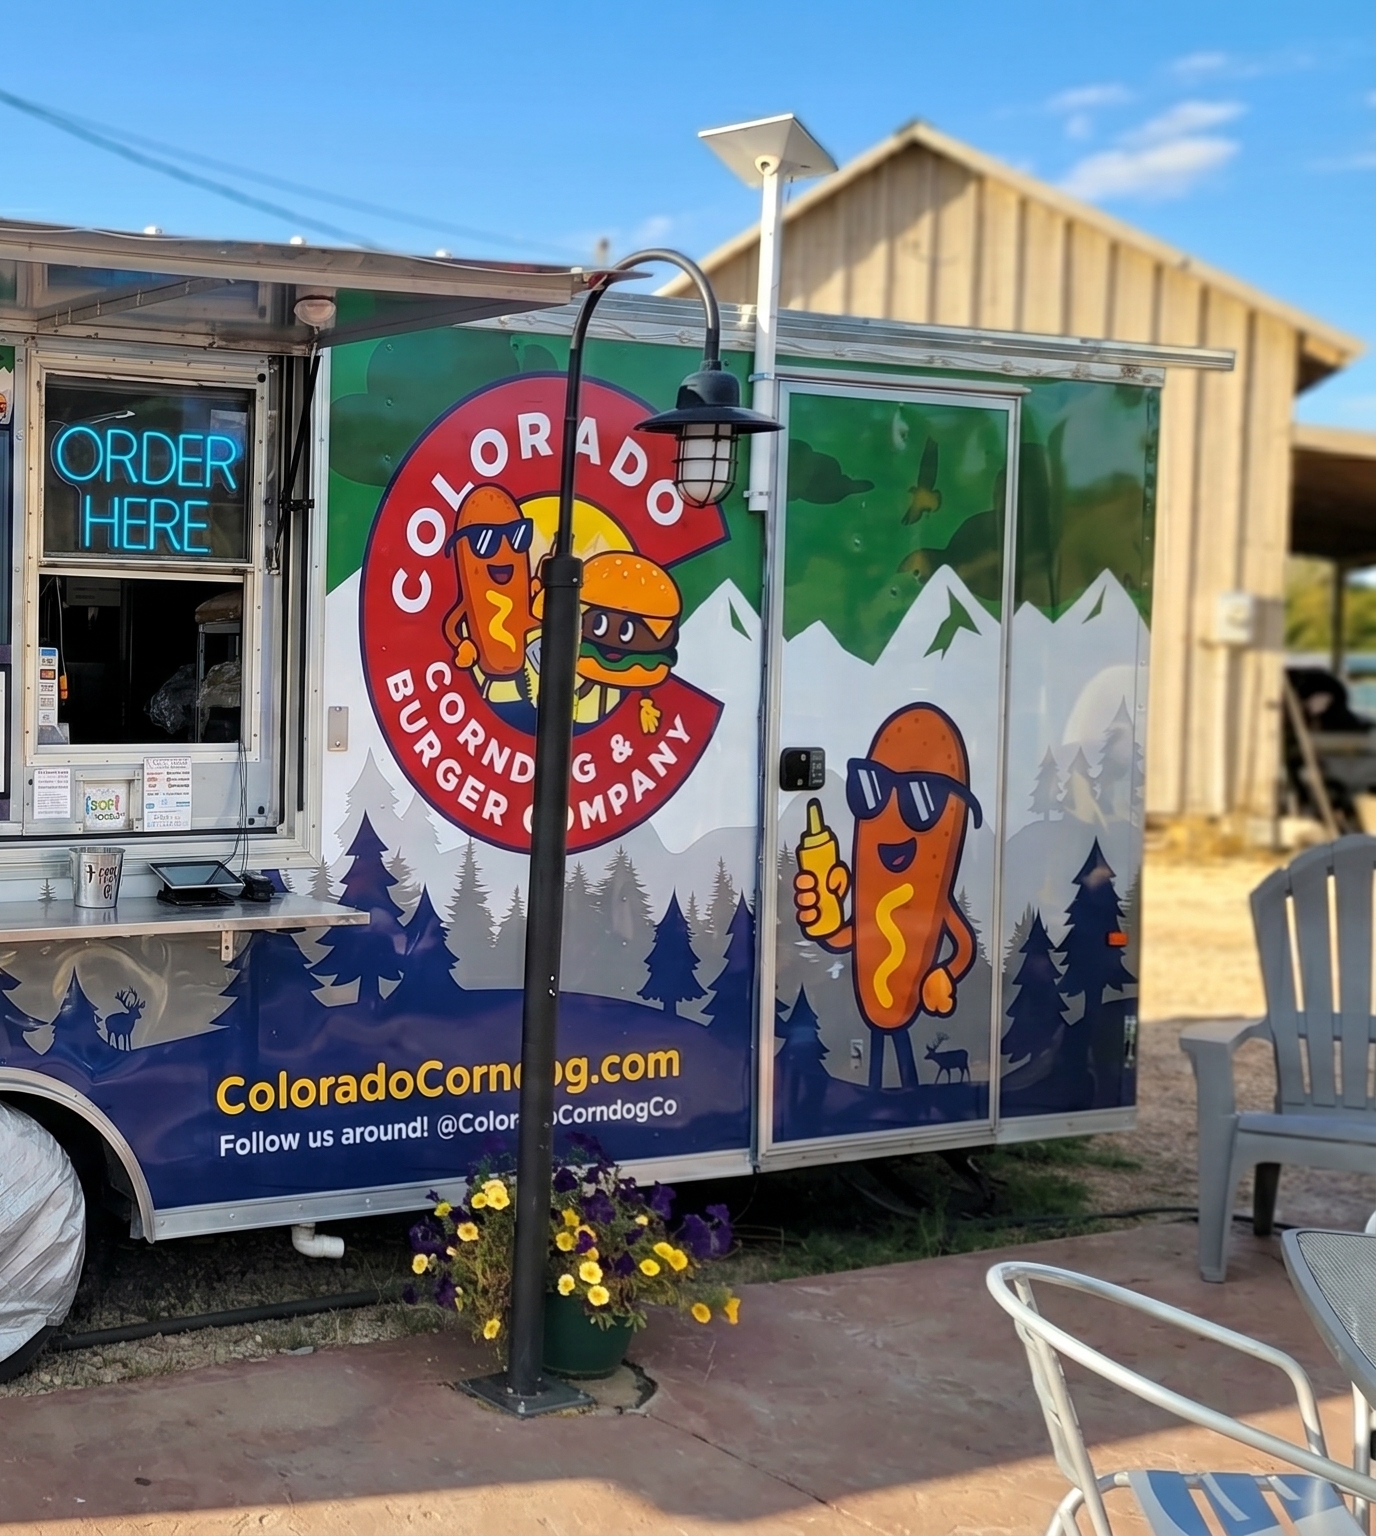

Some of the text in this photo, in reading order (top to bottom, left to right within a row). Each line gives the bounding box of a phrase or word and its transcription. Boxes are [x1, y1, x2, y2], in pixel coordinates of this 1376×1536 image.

[57, 426, 237, 489] ORDER
[85, 495, 212, 553] HERE
[391, 411, 684, 615] COLORADO
[385, 668, 509, 827] BURGER
[425, 660, 634, 784] CORNDG &
[216, 1047, 681, 1116] ColoradoCorng.com
[219, 1096, 678, 1157] Follow us around! @ColorCorndogCo
